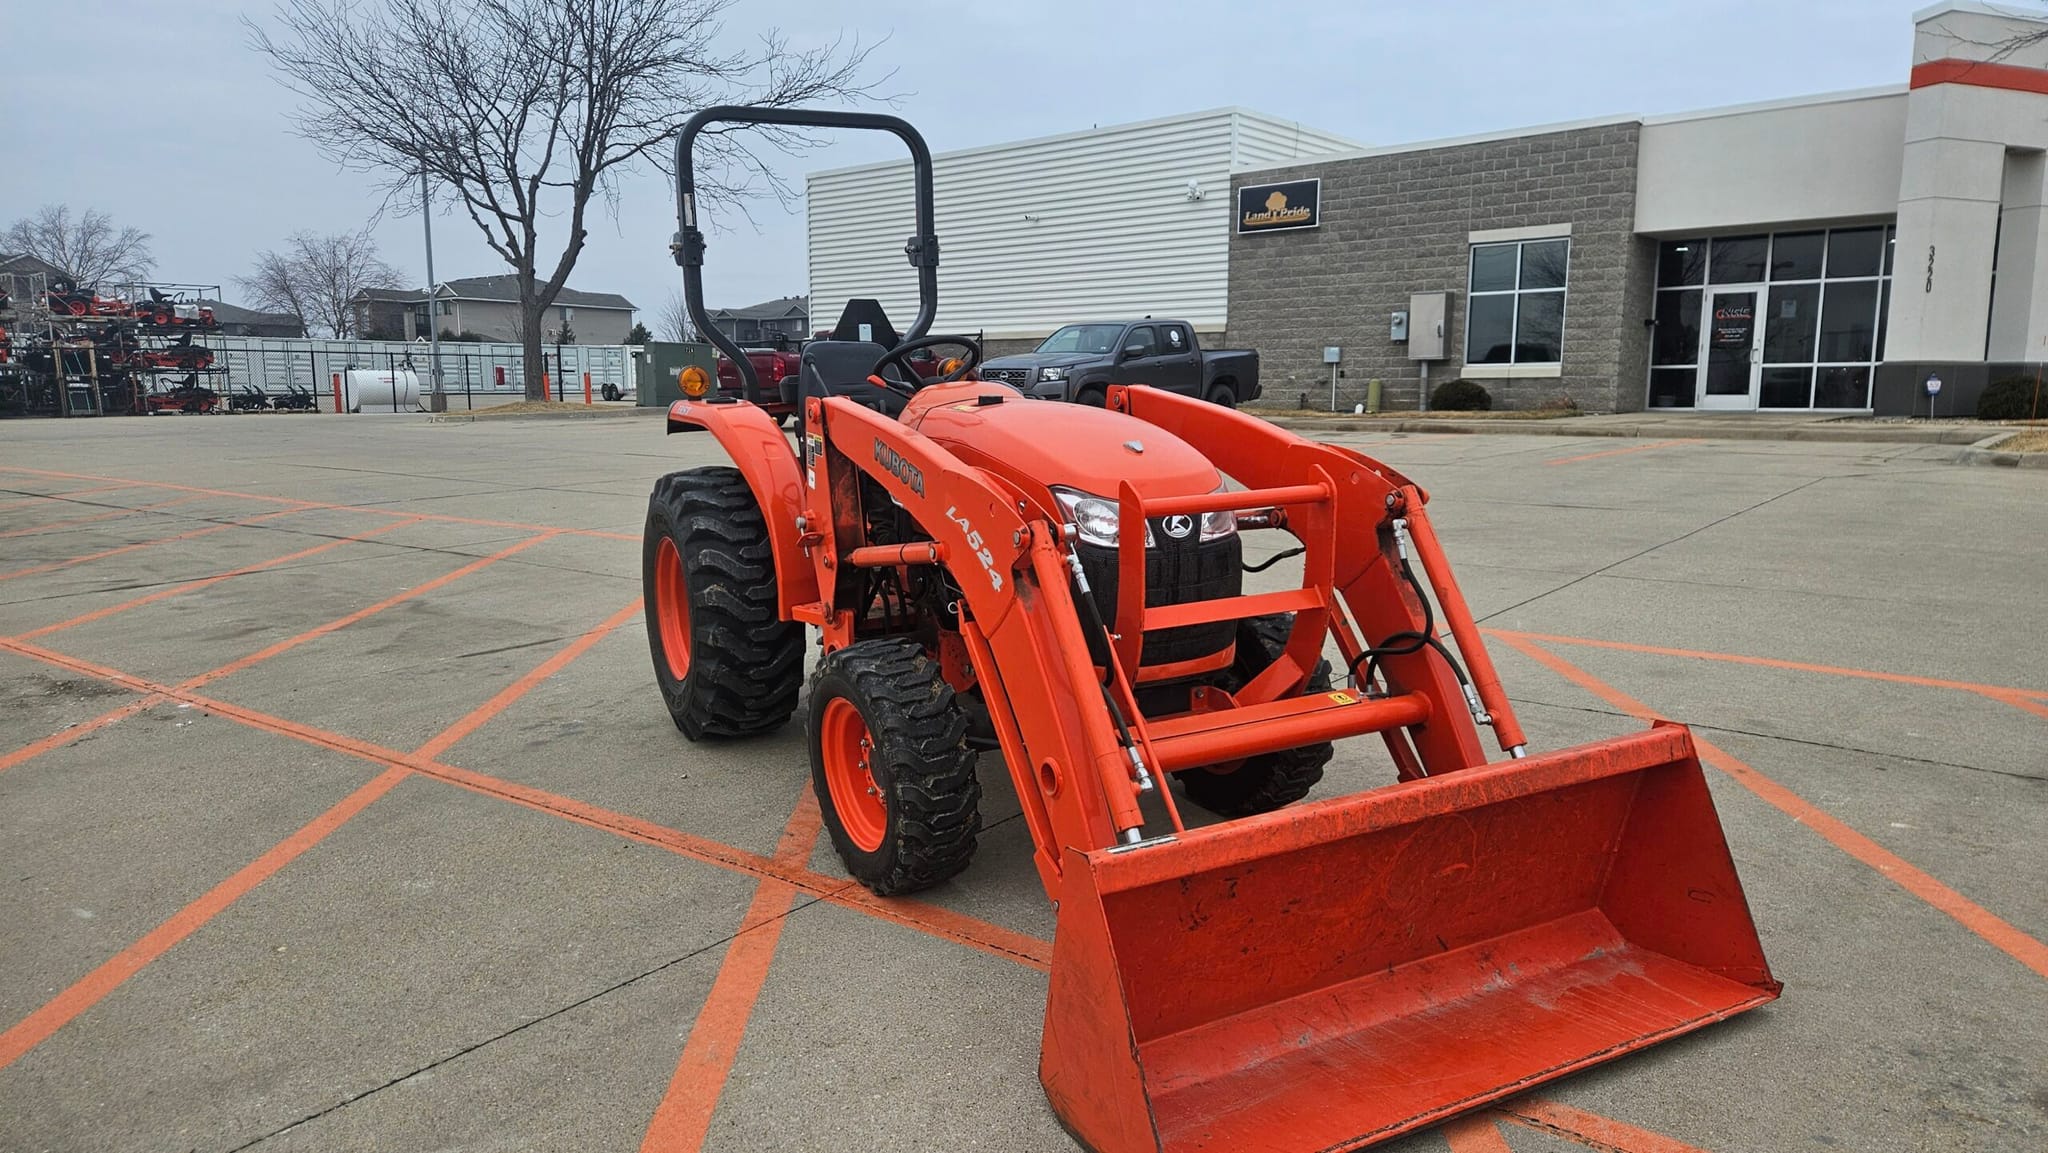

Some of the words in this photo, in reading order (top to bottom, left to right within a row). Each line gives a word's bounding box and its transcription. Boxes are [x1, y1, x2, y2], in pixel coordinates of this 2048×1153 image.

[1280, 205, 1310, 217] Pride
[874, 437, 925, 498] KUBOTA
[945, 505, 1004, 592] LA524
